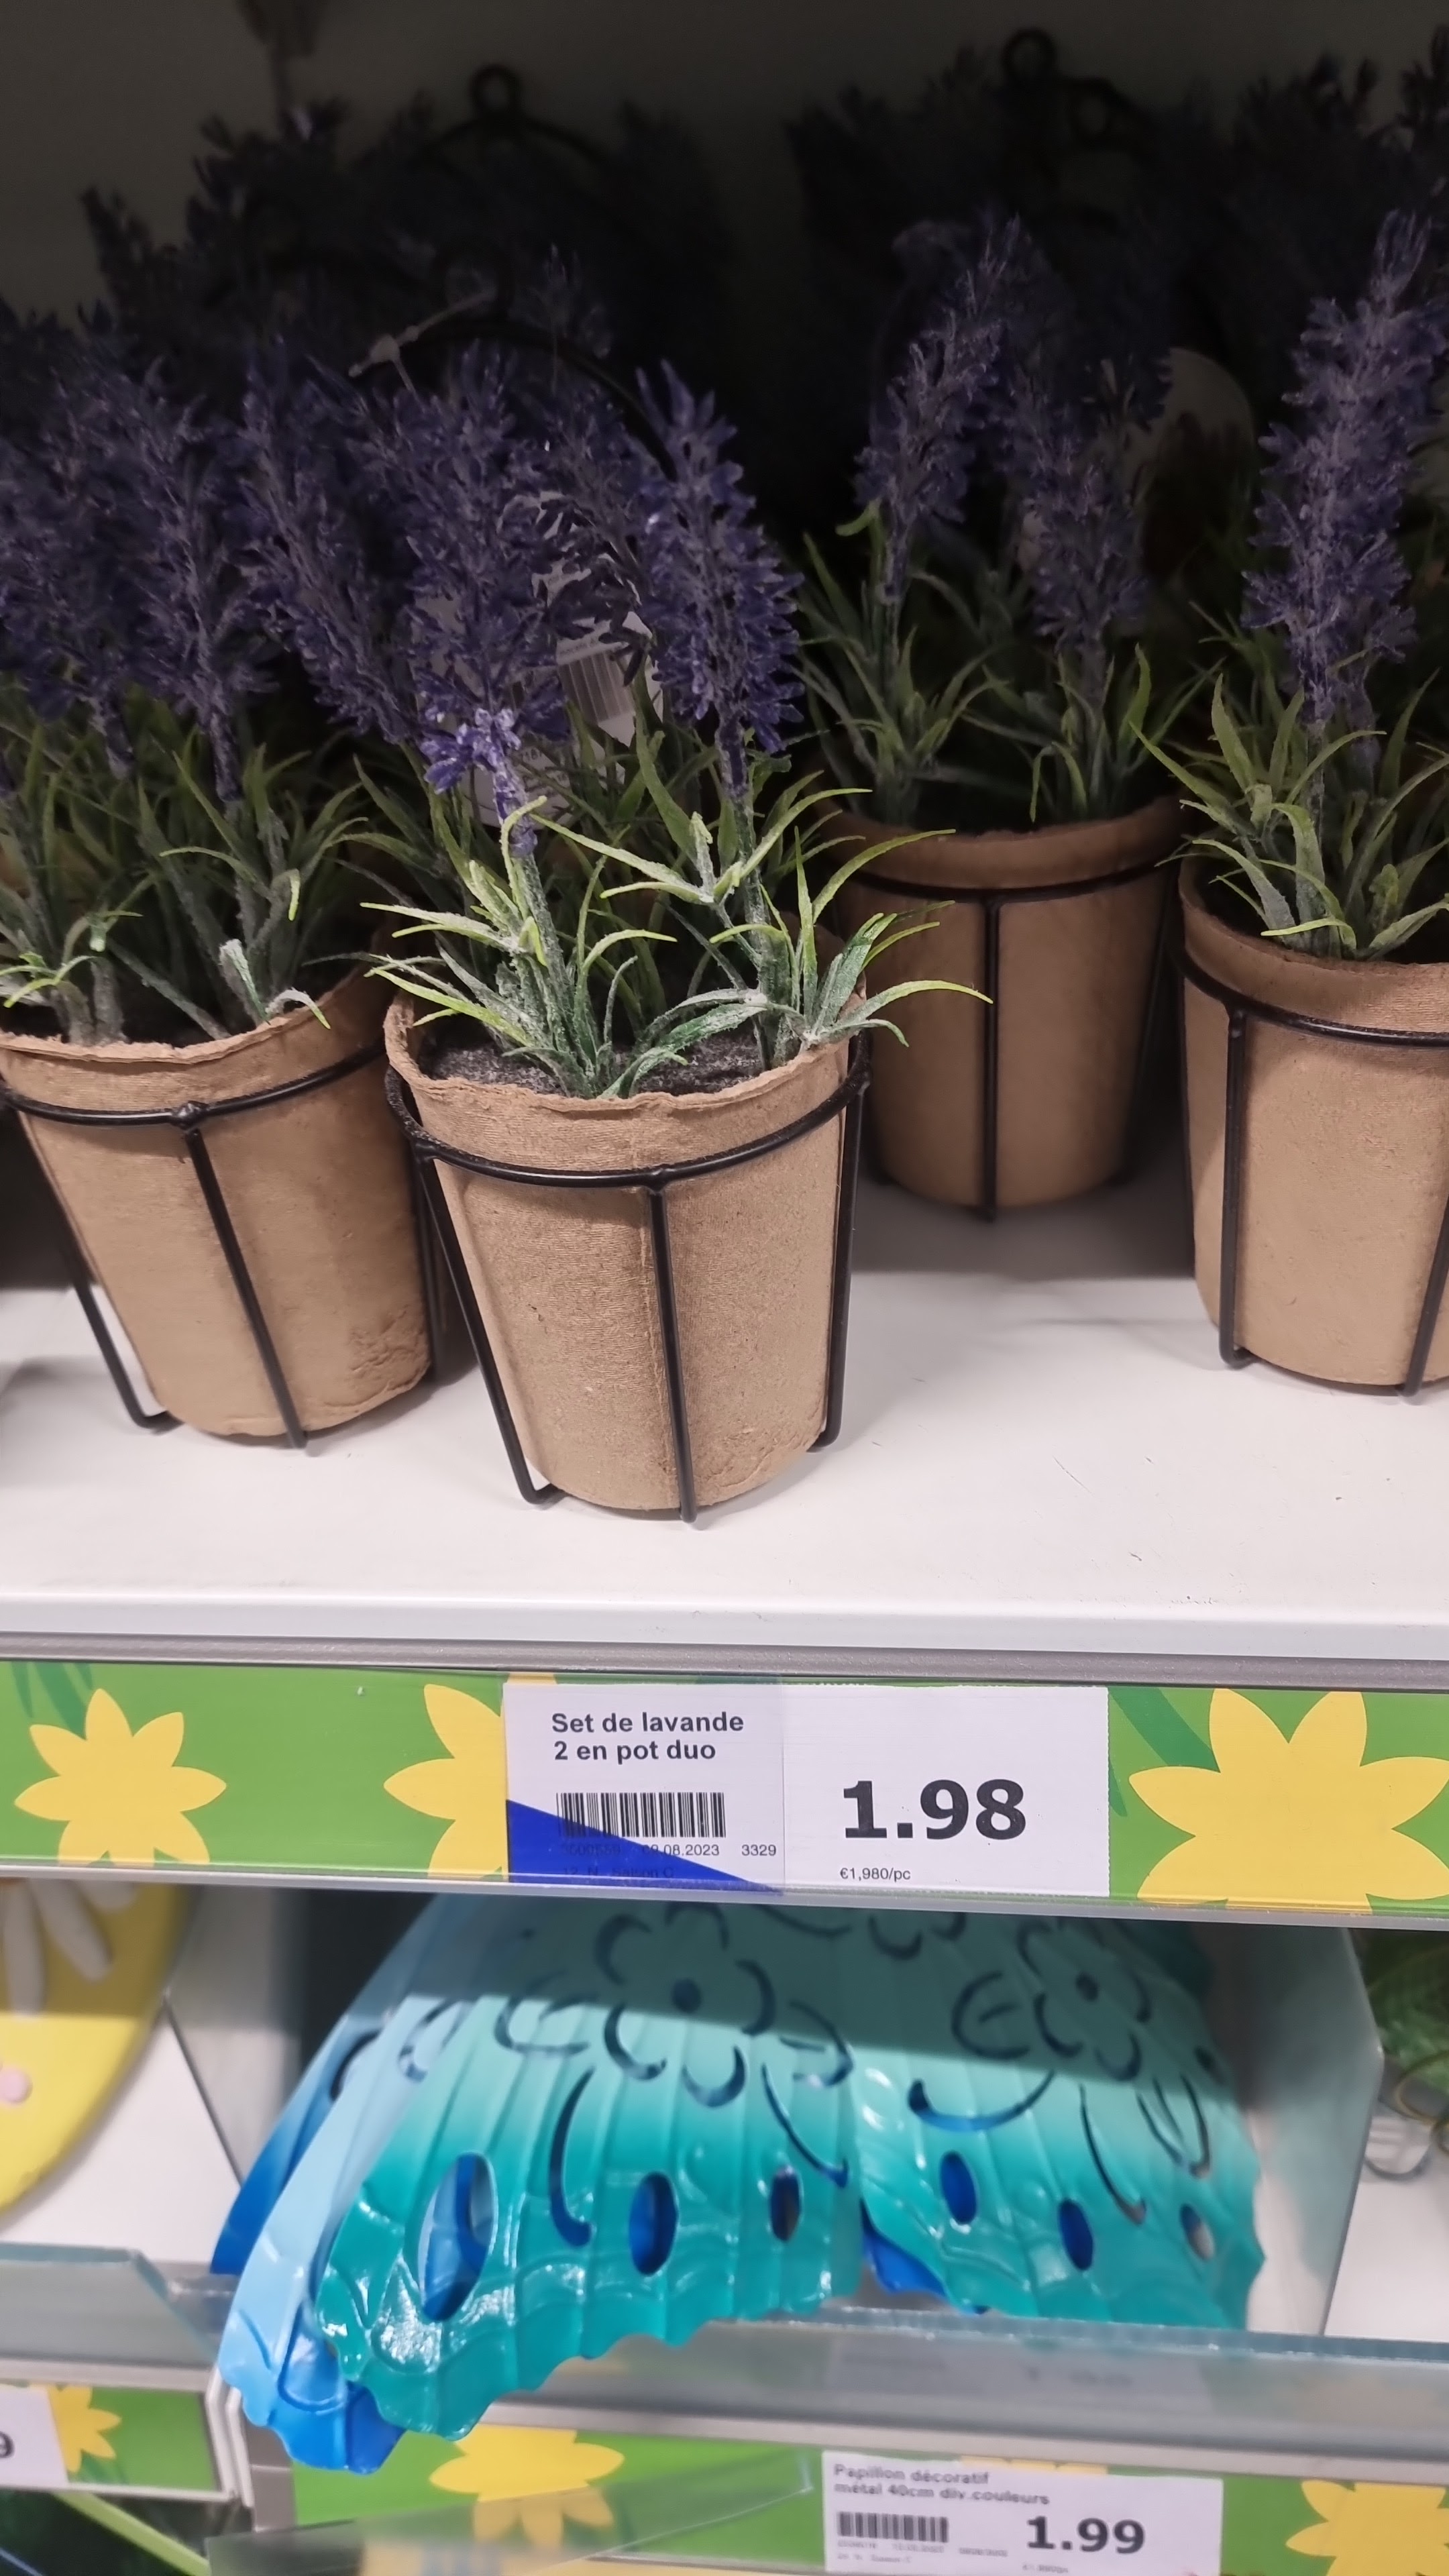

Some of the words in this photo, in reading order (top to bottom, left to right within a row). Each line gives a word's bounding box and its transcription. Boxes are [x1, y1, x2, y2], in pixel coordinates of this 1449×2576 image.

[551, 1713, 594, 1733] Set
[602, 1713, 633, 1732] de
[642, 1711, 744, 1732] lavande
[554, 1741, 568, 1760] 2
[576, 1745, 607, 1760] en
[617, 1741, 659, 1765] pot
[666, 1739, 716, 1760] duo
[843, 1779, 1026, 1840] 1.98
[641, 1844, 720, 1856] 09.08.2023
[741, 1844, 777, 1856] 3329
[840, 1868, 911, 1882] €1,980/pc
[834, 2463, 905, 2480] Papillon
[911, 2469, 989, 2484] décoratif
[888, 2483, 934, 2496] 40cm
[1026, 2516, 1145, 2555] 1.99
